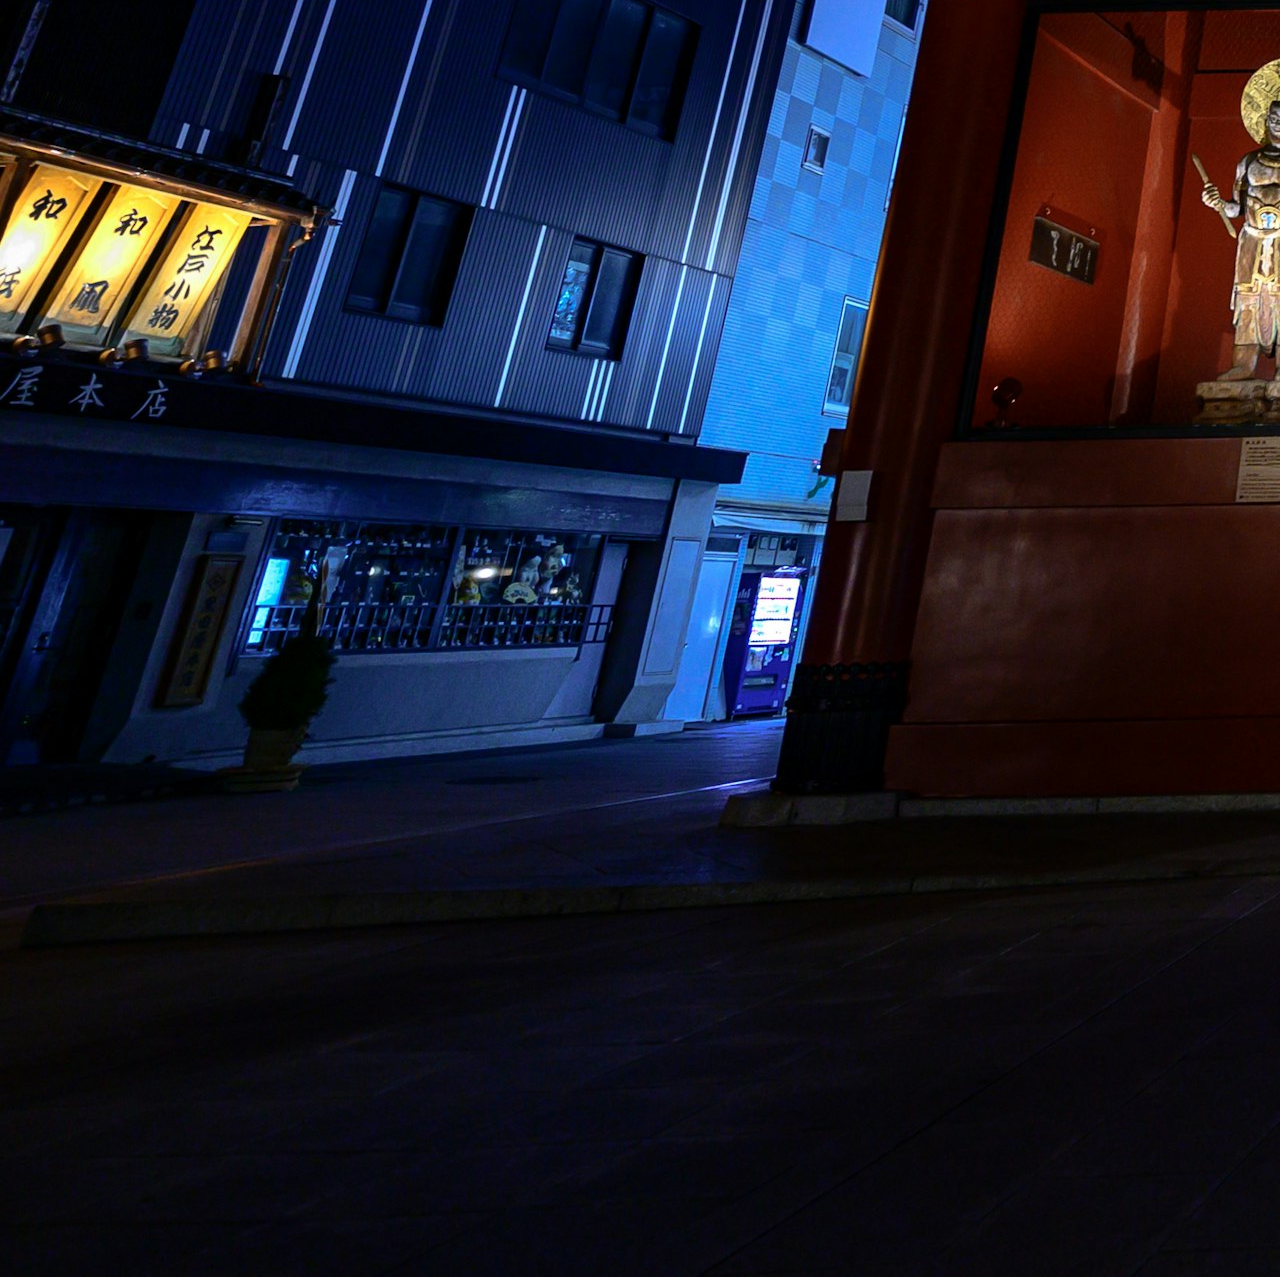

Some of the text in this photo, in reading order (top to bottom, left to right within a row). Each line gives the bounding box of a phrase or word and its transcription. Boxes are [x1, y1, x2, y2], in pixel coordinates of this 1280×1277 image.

[147, 225, 223, 330] 江戸小物
[0, 365, 170, 420] 屋本店
